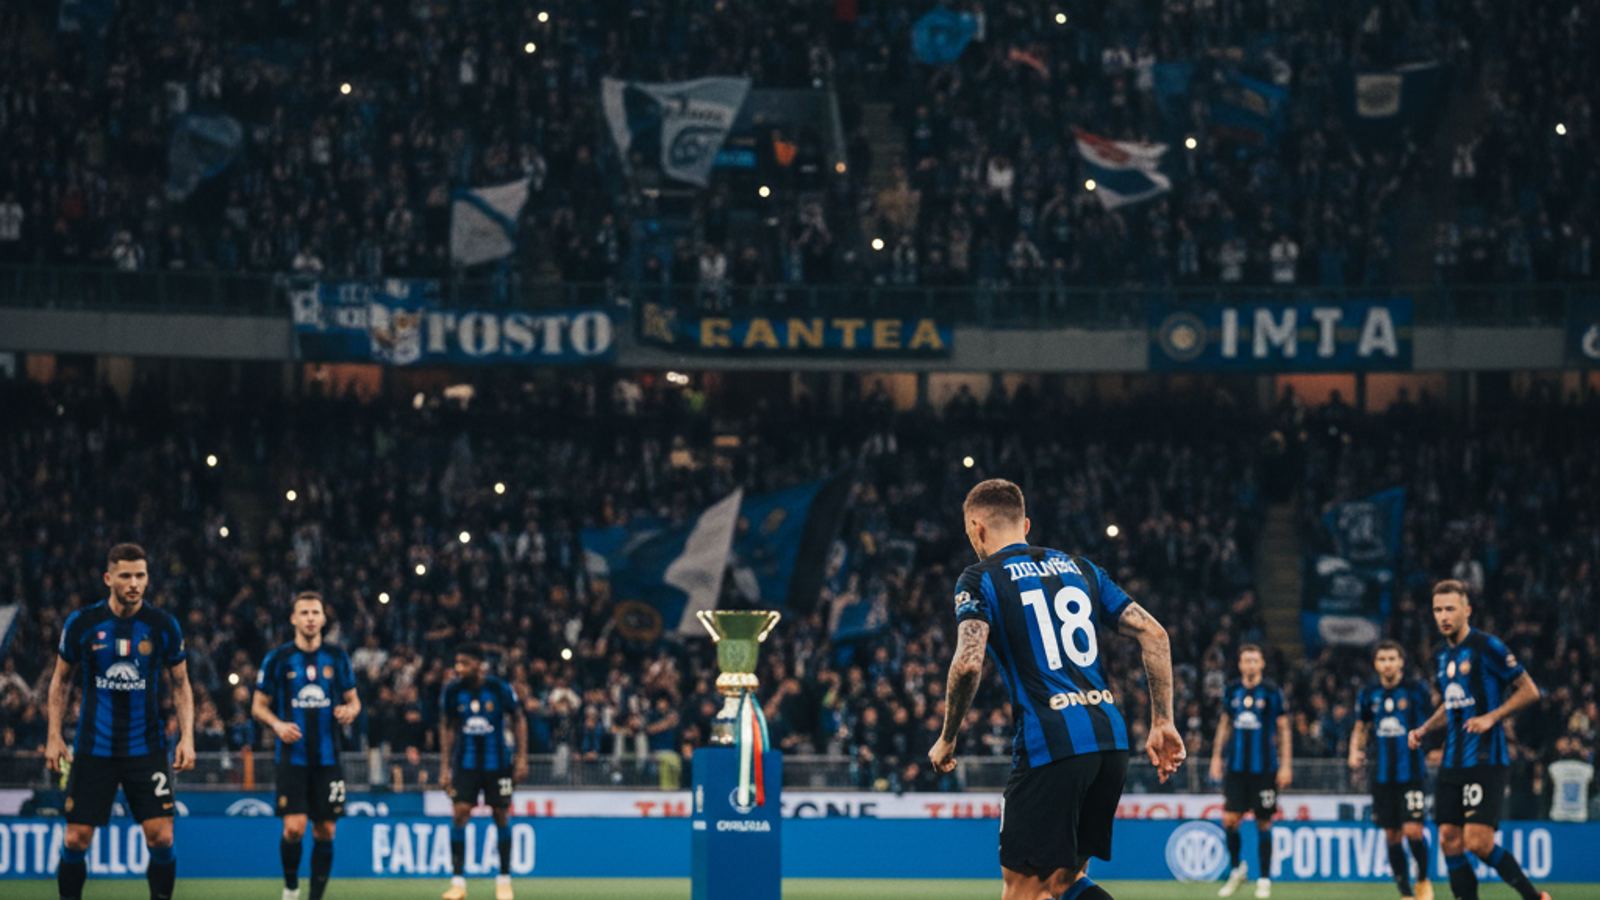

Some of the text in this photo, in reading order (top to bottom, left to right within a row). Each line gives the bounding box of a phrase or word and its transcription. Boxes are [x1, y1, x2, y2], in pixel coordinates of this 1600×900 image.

[1221, 307, 1398, 358] IMTA
[1019, 585, 1098, 671] 18
[151, 771, 170, 797] 2
